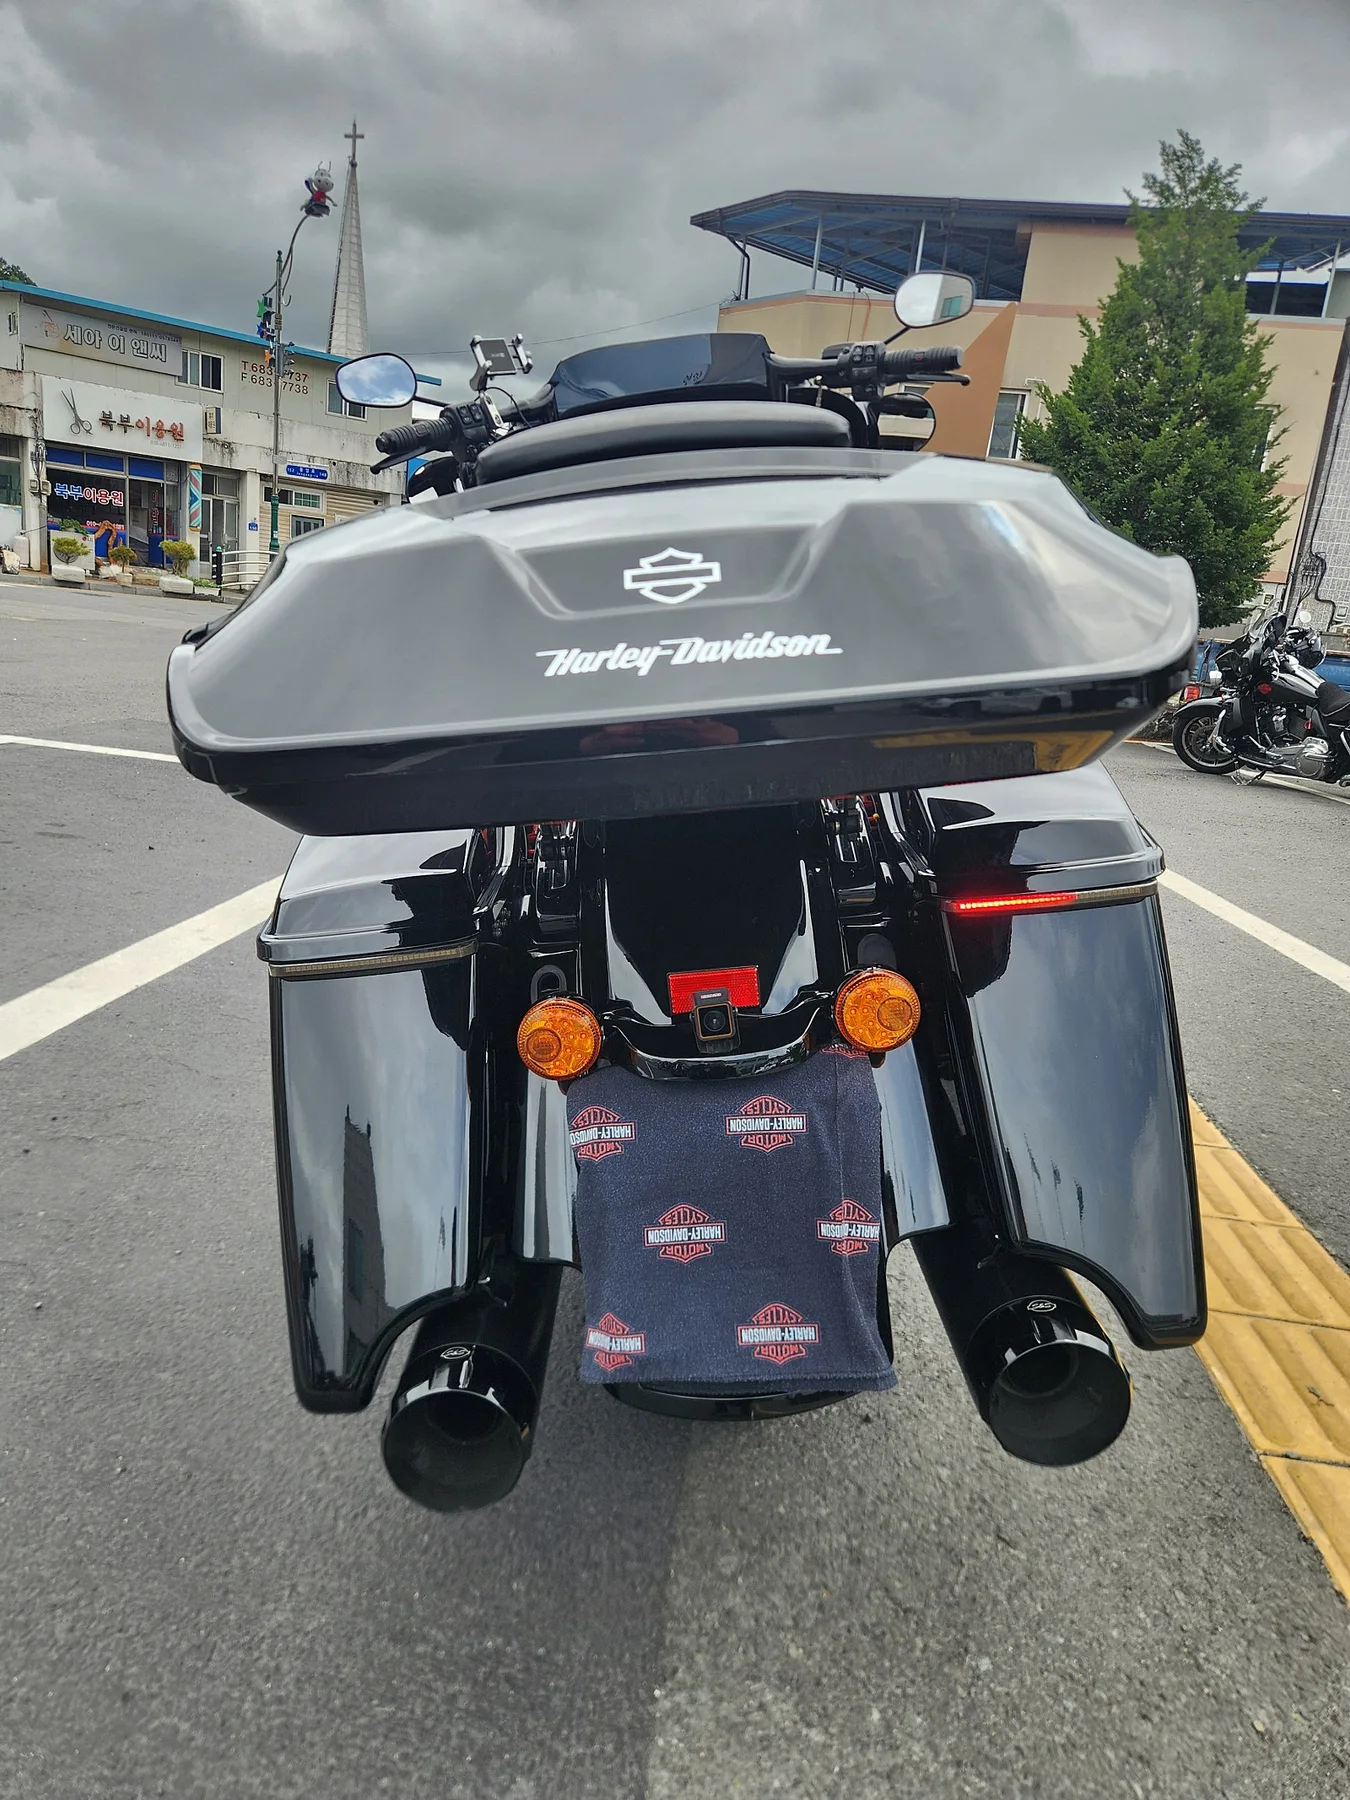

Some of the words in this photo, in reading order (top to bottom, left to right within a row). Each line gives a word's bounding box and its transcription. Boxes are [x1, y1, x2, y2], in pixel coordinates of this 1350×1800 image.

[64, 323, 102, 350] 세아
[241, 372, 309, 394] F.6837738
[98, 410, 185, 442] 북부이용원
[54, 482, 124, 507] 북부이용원
[535, 631, 843, 677] Harley-Davidson
[745, 1098, 786, 1115] CYCLES
[577, 1108, 614, 1127] CYCLES
[730, 1116, 803, 1132] HARLEY-DAVIDSON
[569, 1125, 632, 1145] HARLEY-DAVIDSO
[747, 1133, 787, 1149] MOTOR
[580, 1142, 615, 1157] MOTOR
[664, 1207, 704, 1225] CYCLES
[647, 1225, 722, 1244] HARLEY-DAVIDSON
[666, 1243, 705, 1259] MOTOR
[758, 1306, 797, 1325] CYCLES
[741, 1326, 816, 1343] HARLEY-DAVIDSON
[760, 1344, 799, 1360] MOTOR
